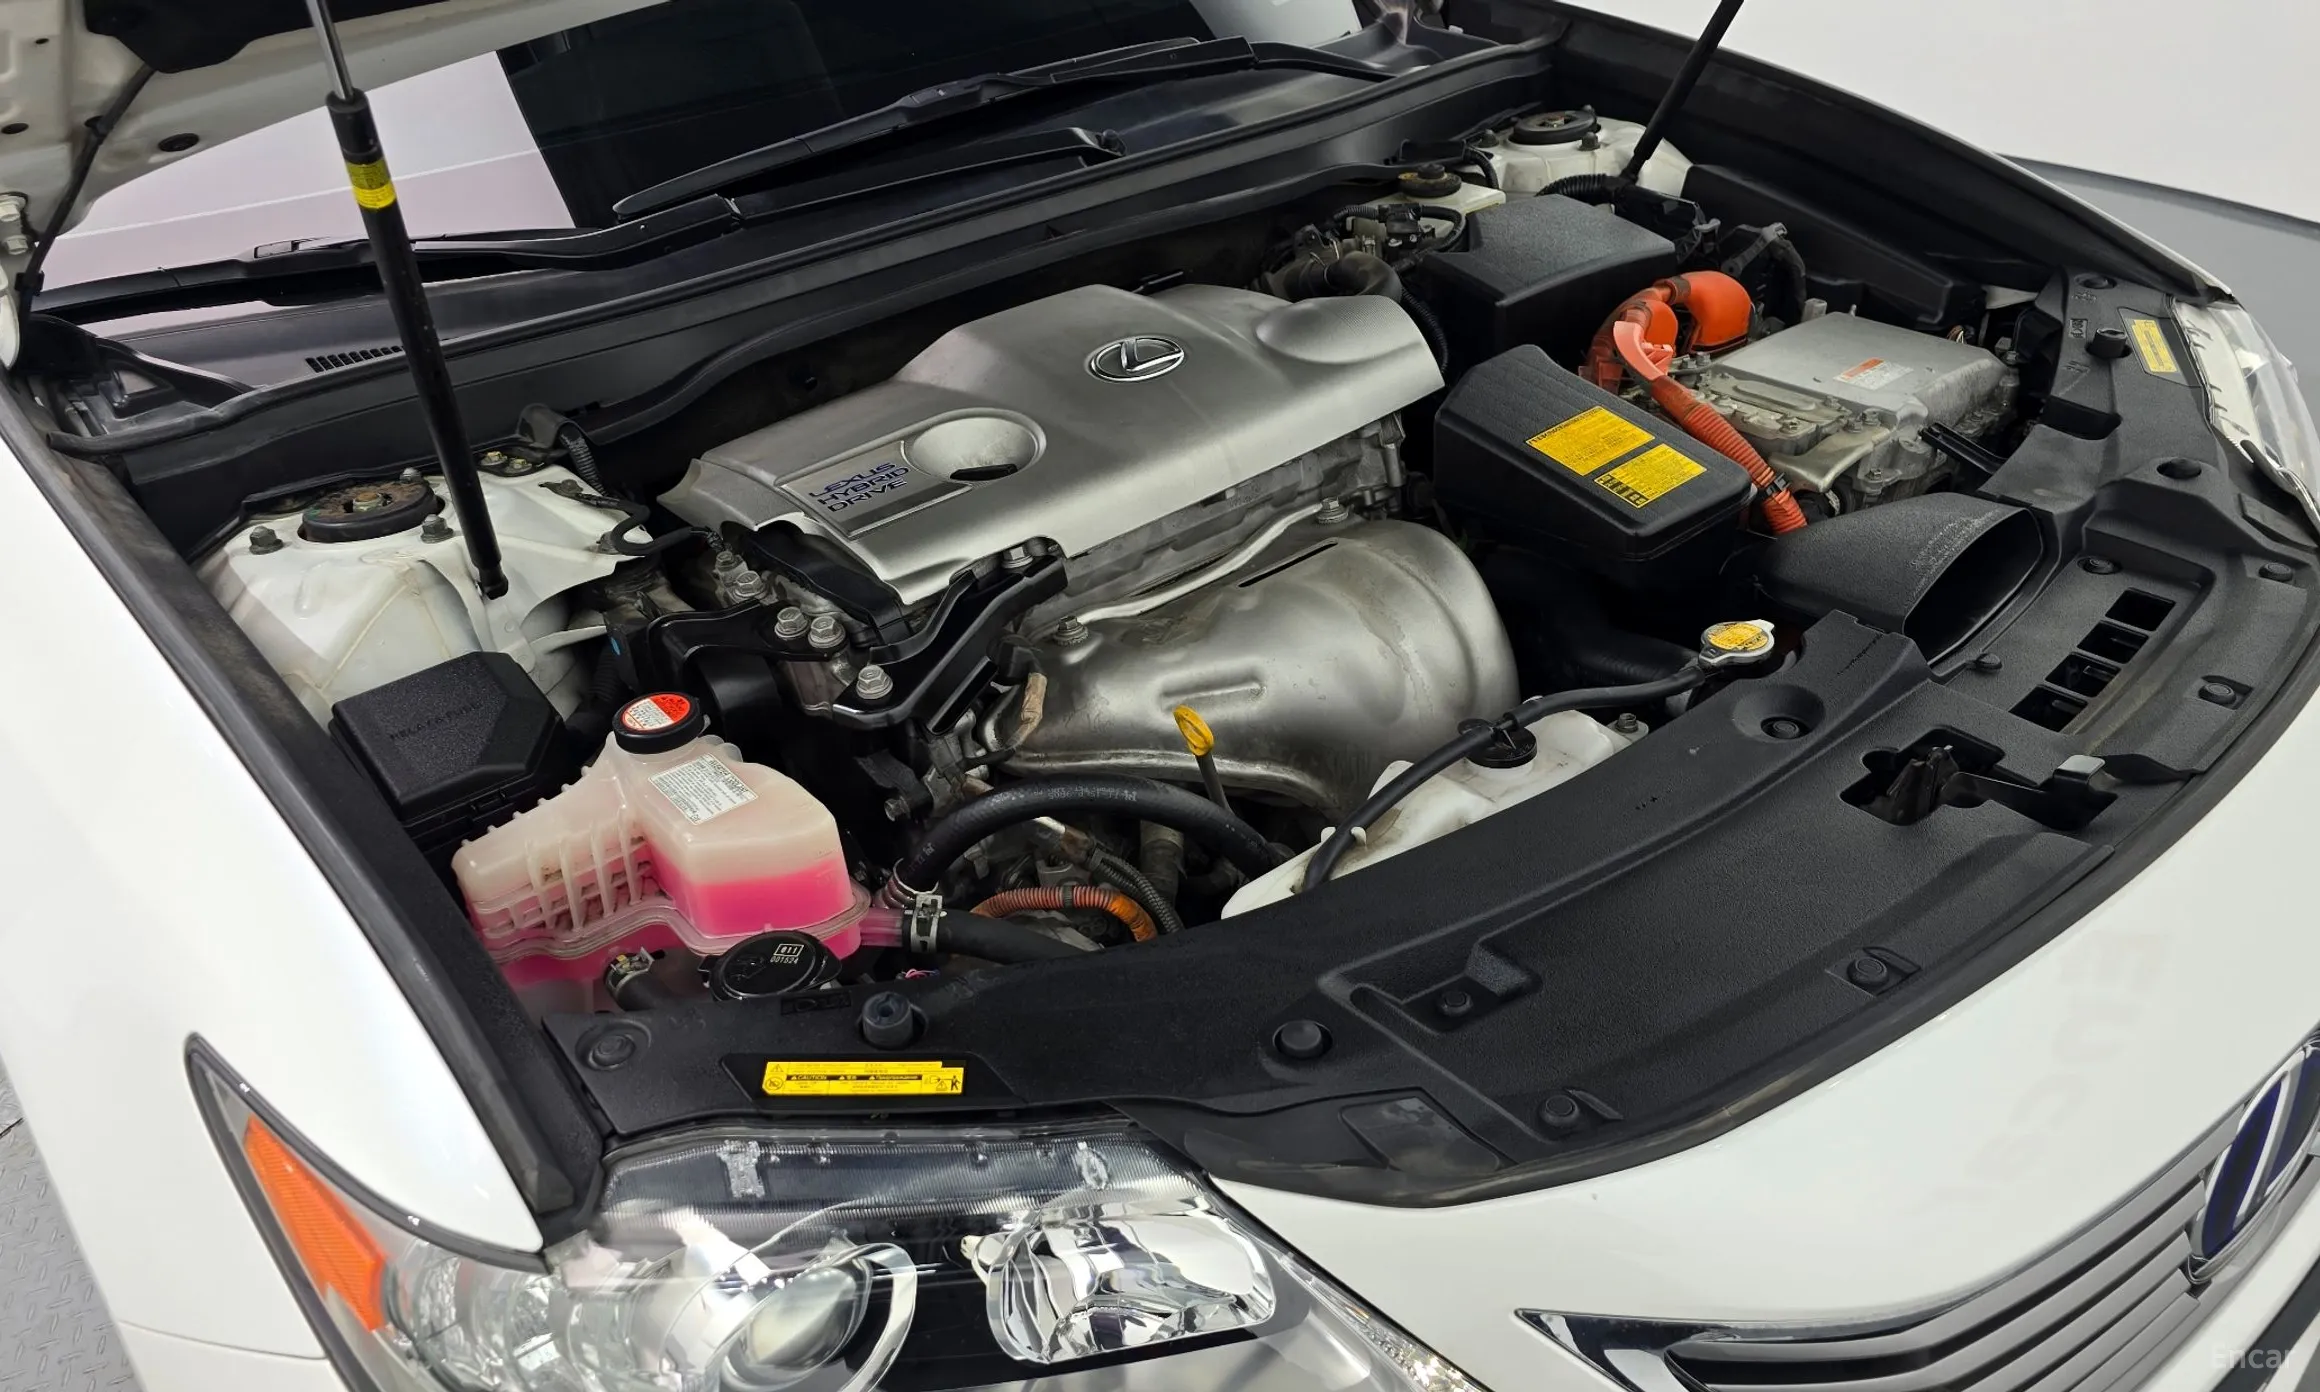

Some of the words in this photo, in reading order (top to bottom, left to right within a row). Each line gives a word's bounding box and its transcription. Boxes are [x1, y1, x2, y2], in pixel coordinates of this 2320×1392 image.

[808, 462, 896, 497] LEXUS
[817, 467, 909, 505] HYBRID
[827, 479, 908, 512] DRIVE
